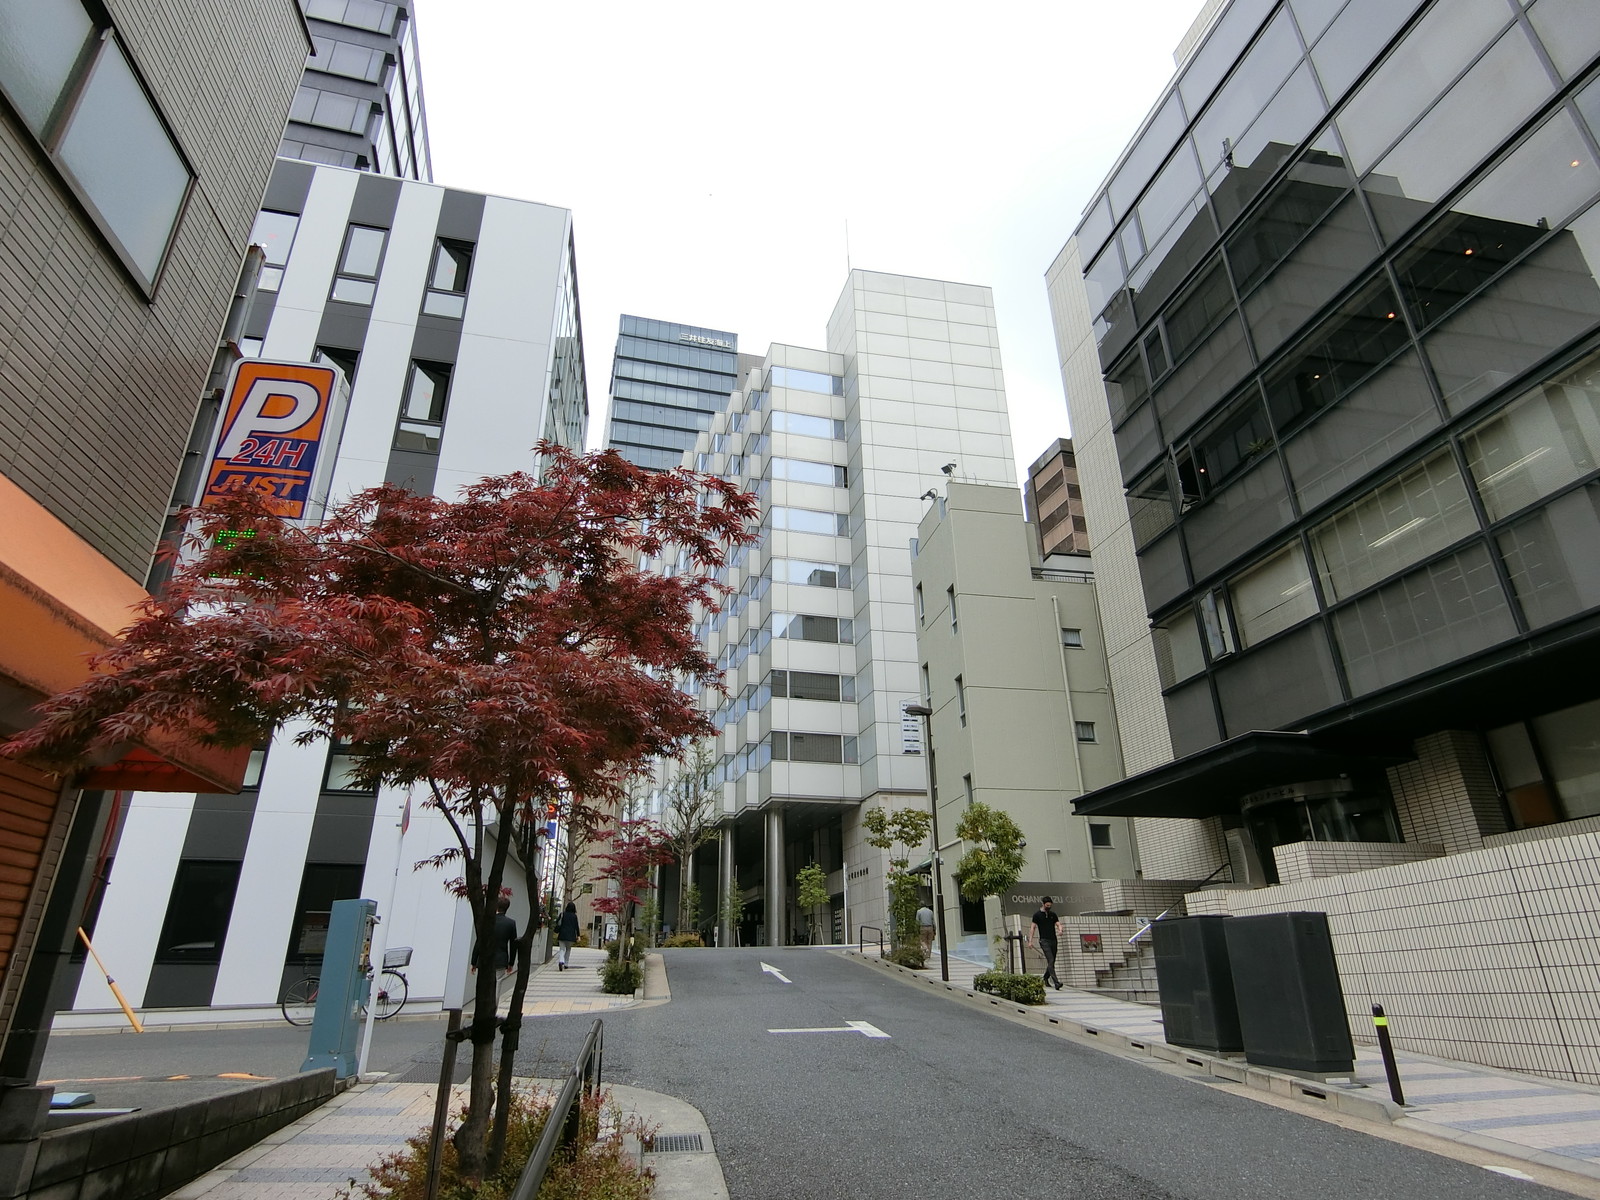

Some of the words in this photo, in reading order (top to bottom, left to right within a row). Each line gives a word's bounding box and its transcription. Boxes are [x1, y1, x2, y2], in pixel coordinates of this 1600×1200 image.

[680, 332, 731, 348] 三井住友海上
[217, 377, 320, 458] P
[230, 438, 308, 467] 24H
